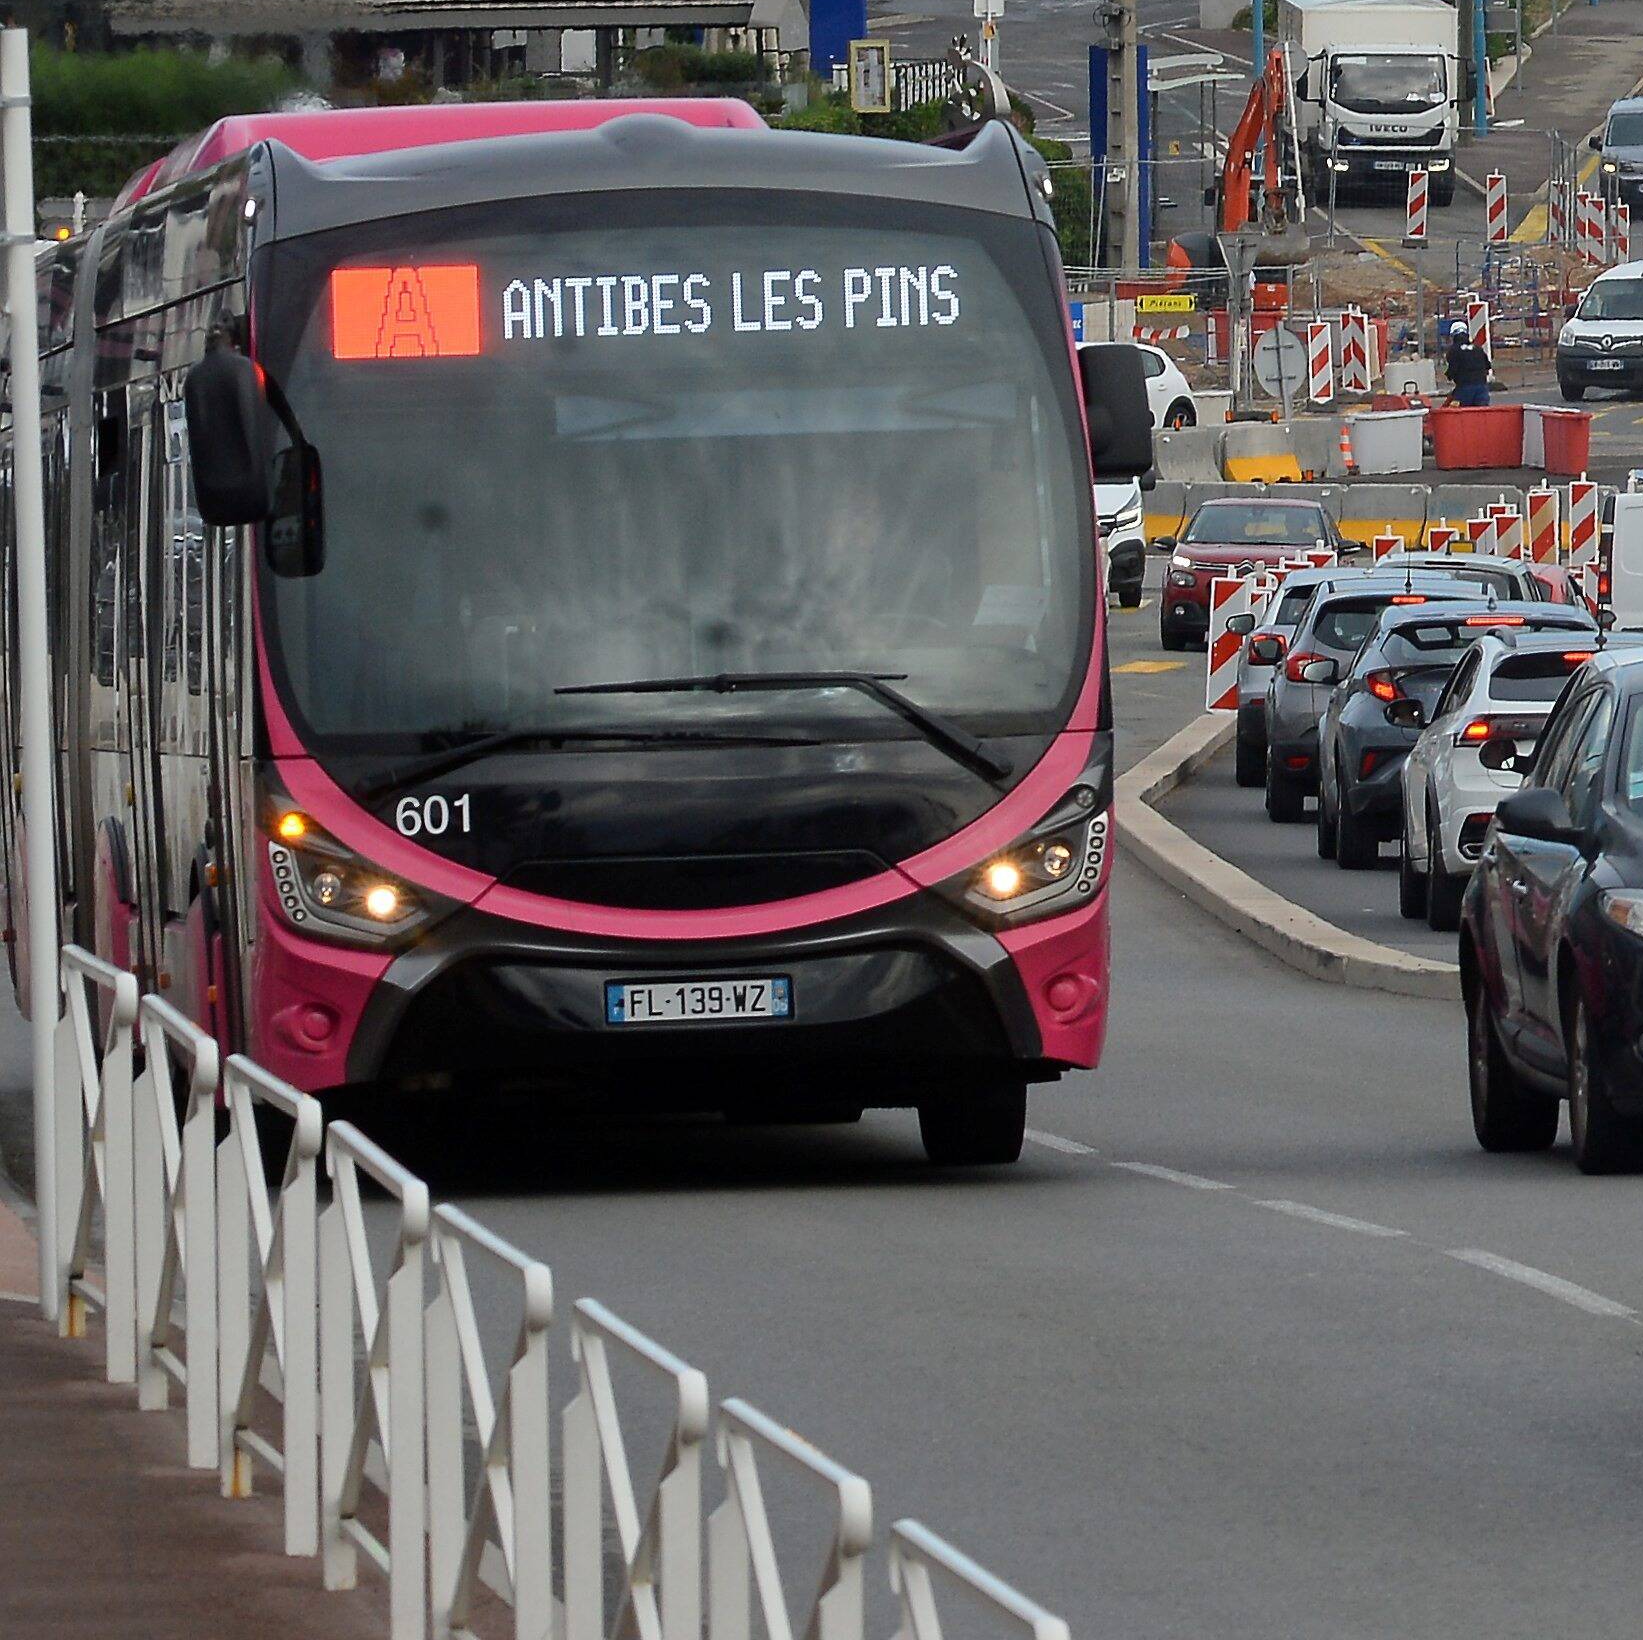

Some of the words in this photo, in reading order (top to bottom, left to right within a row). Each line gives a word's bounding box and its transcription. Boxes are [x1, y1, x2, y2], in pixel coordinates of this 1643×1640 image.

[377, 265, 440, 358] A
[503, 274, 712, 340] ANTIBES
[731, 269, 823, 332] LES
[843, 264, 960, 329] PINS
[396, 793, 471, 836] 601
[630, 984, 767, 1018] FL-139-WZ
